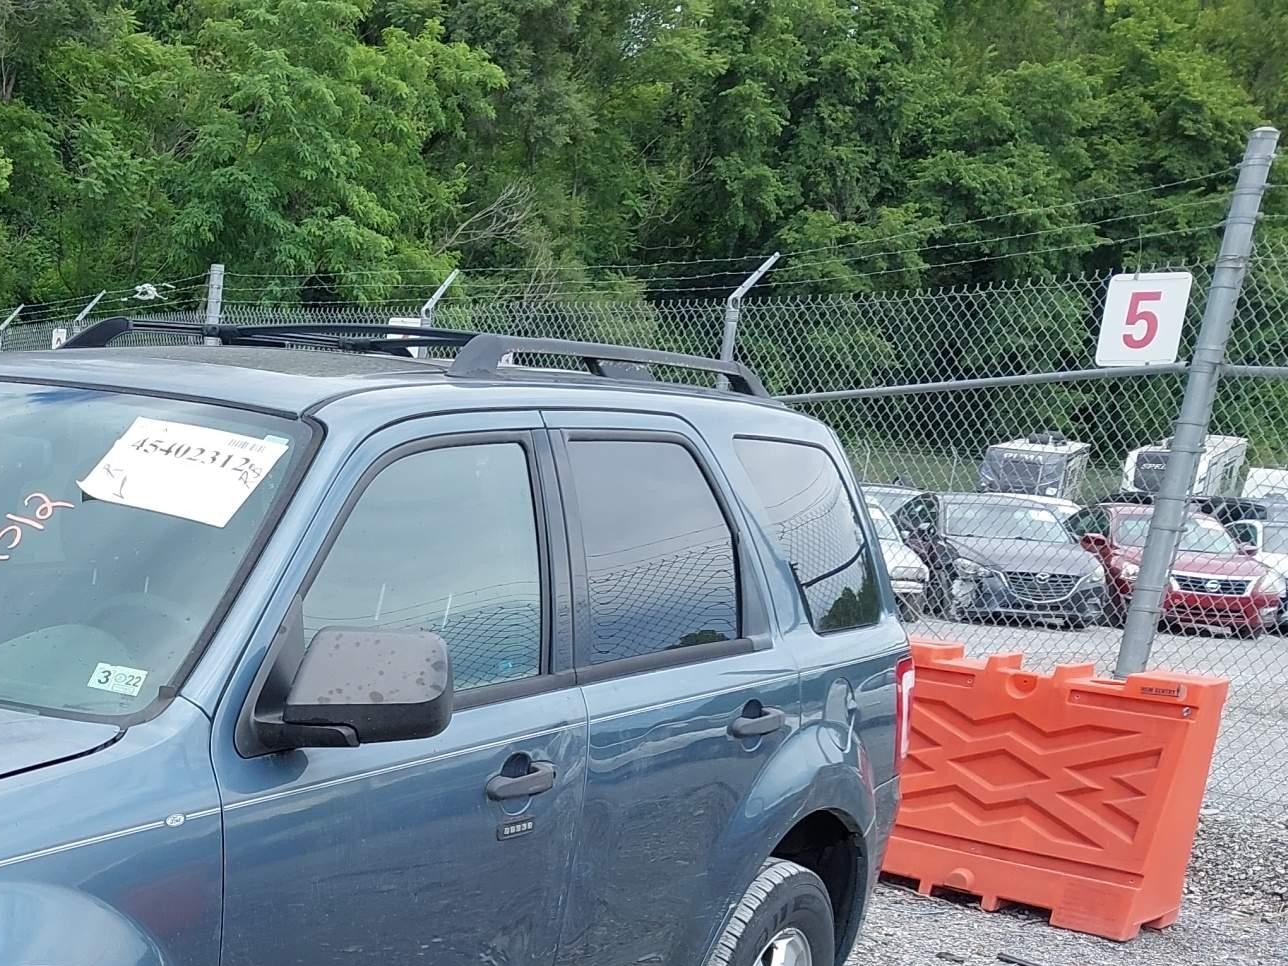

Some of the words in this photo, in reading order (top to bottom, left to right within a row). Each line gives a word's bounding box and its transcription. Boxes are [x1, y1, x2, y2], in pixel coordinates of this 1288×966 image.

[1122, 290, 1162, 349] 5
[130, 436, 250, 472] 45402312
[97, 670, 112, 684] 3
[125, 674, 142, 687] 22
